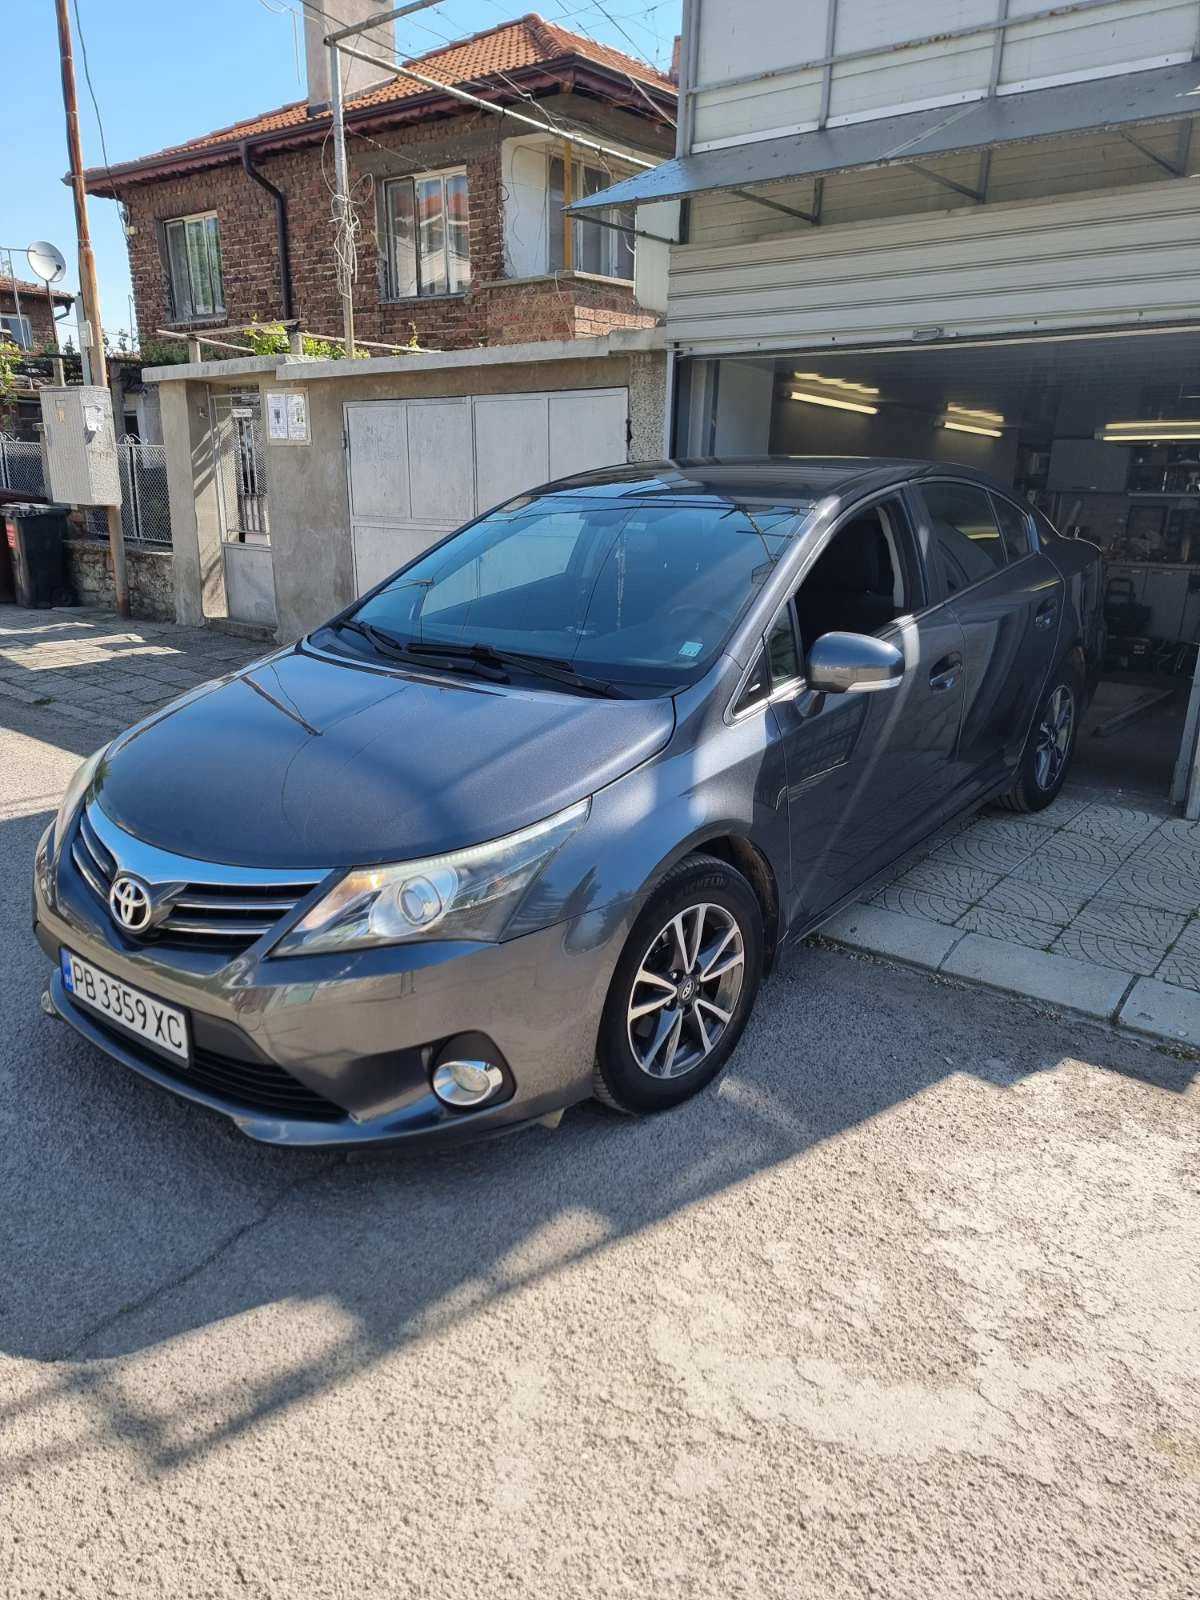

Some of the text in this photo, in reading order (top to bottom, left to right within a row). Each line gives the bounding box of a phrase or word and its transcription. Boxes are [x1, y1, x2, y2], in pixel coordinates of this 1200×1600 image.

[73, 962, 182, 1048] PB 3359 XC
